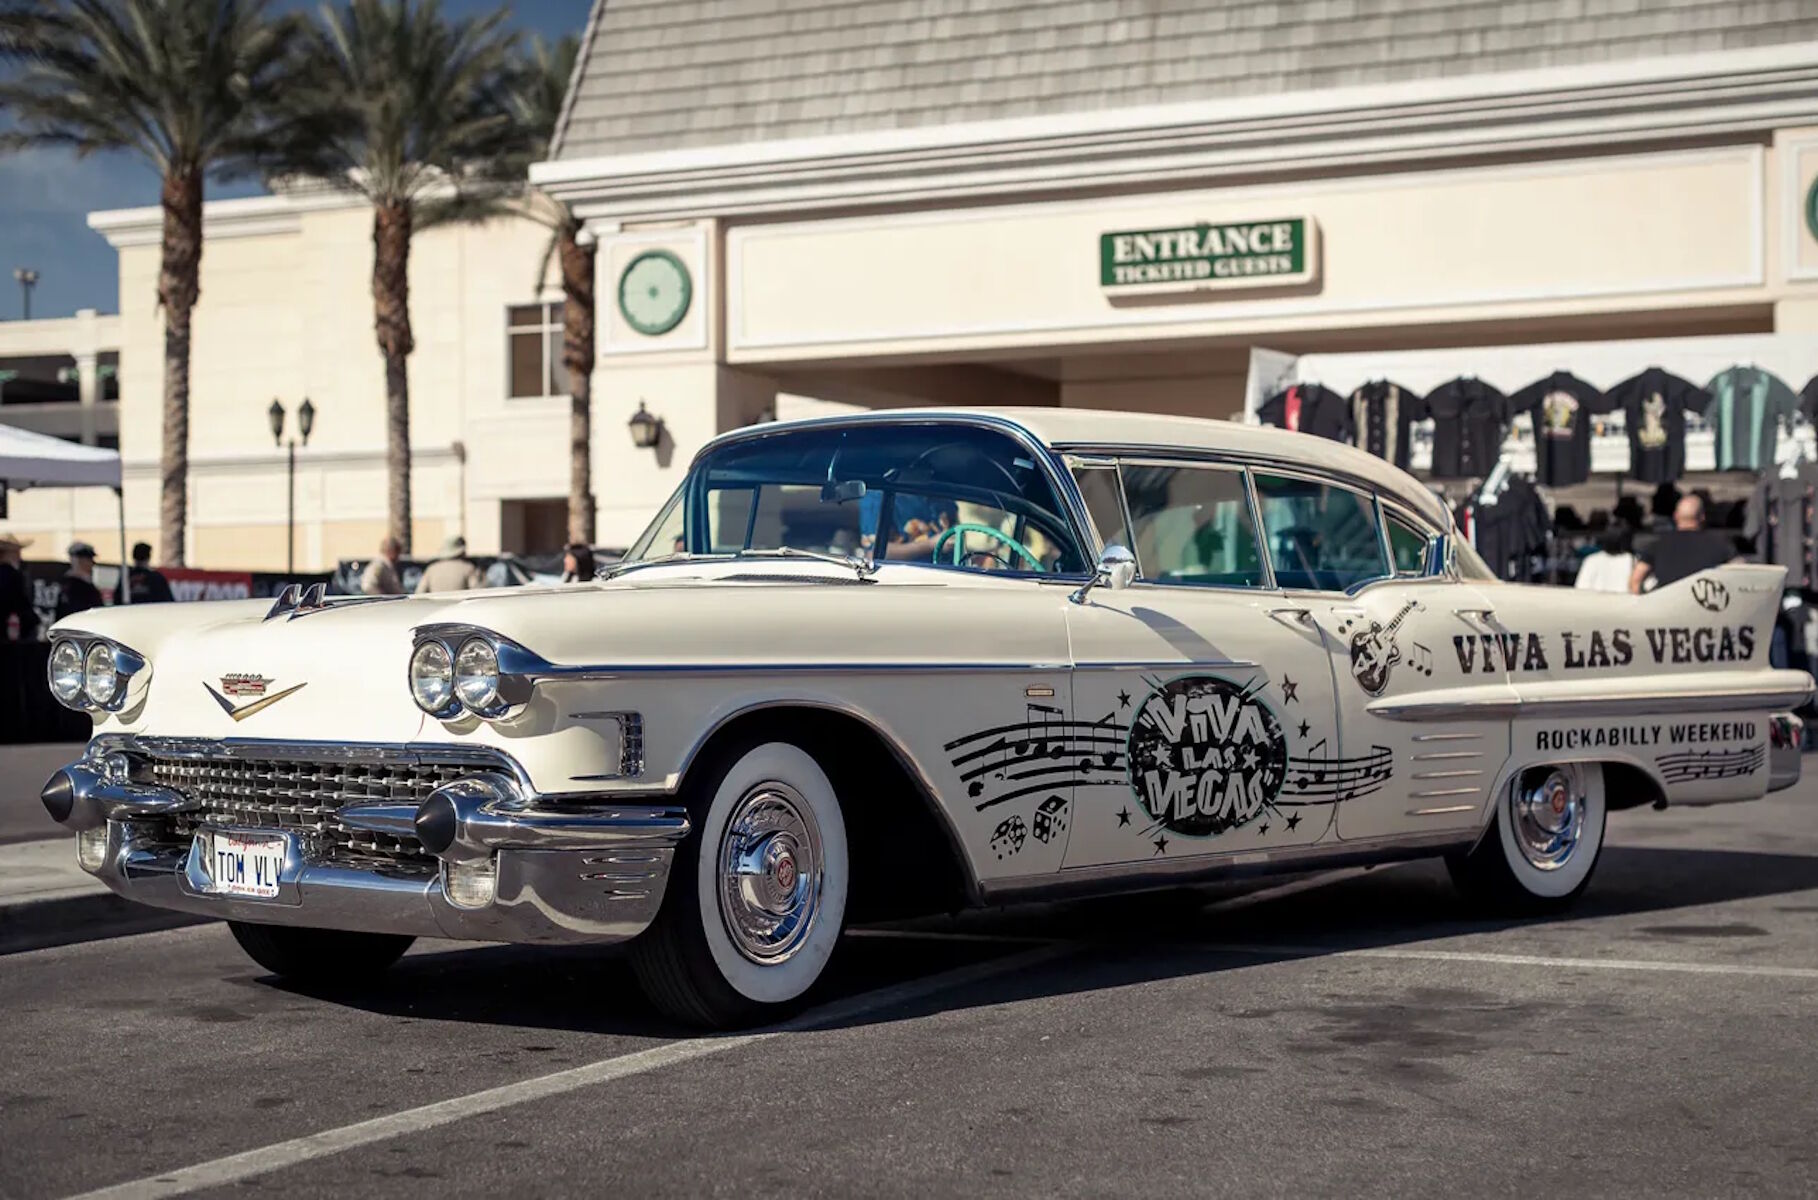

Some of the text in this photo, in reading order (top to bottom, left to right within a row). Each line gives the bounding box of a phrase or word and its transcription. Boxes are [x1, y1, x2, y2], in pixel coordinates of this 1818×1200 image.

[1112, 222, 1293, 263] ENTRANCE
[1112, 253, 1292, 284] TICKETED GUESTS
[1453, 626, 1755, 675] VIVA LAS VEGAS
[1536, 722, 1756, 751] ROCKABILLY WEEKEND
[1181, 746, 1237, 770] LAS
[1144, 768, 1265, 821] VEGAS
[217, 851, 245, 884] TOM
